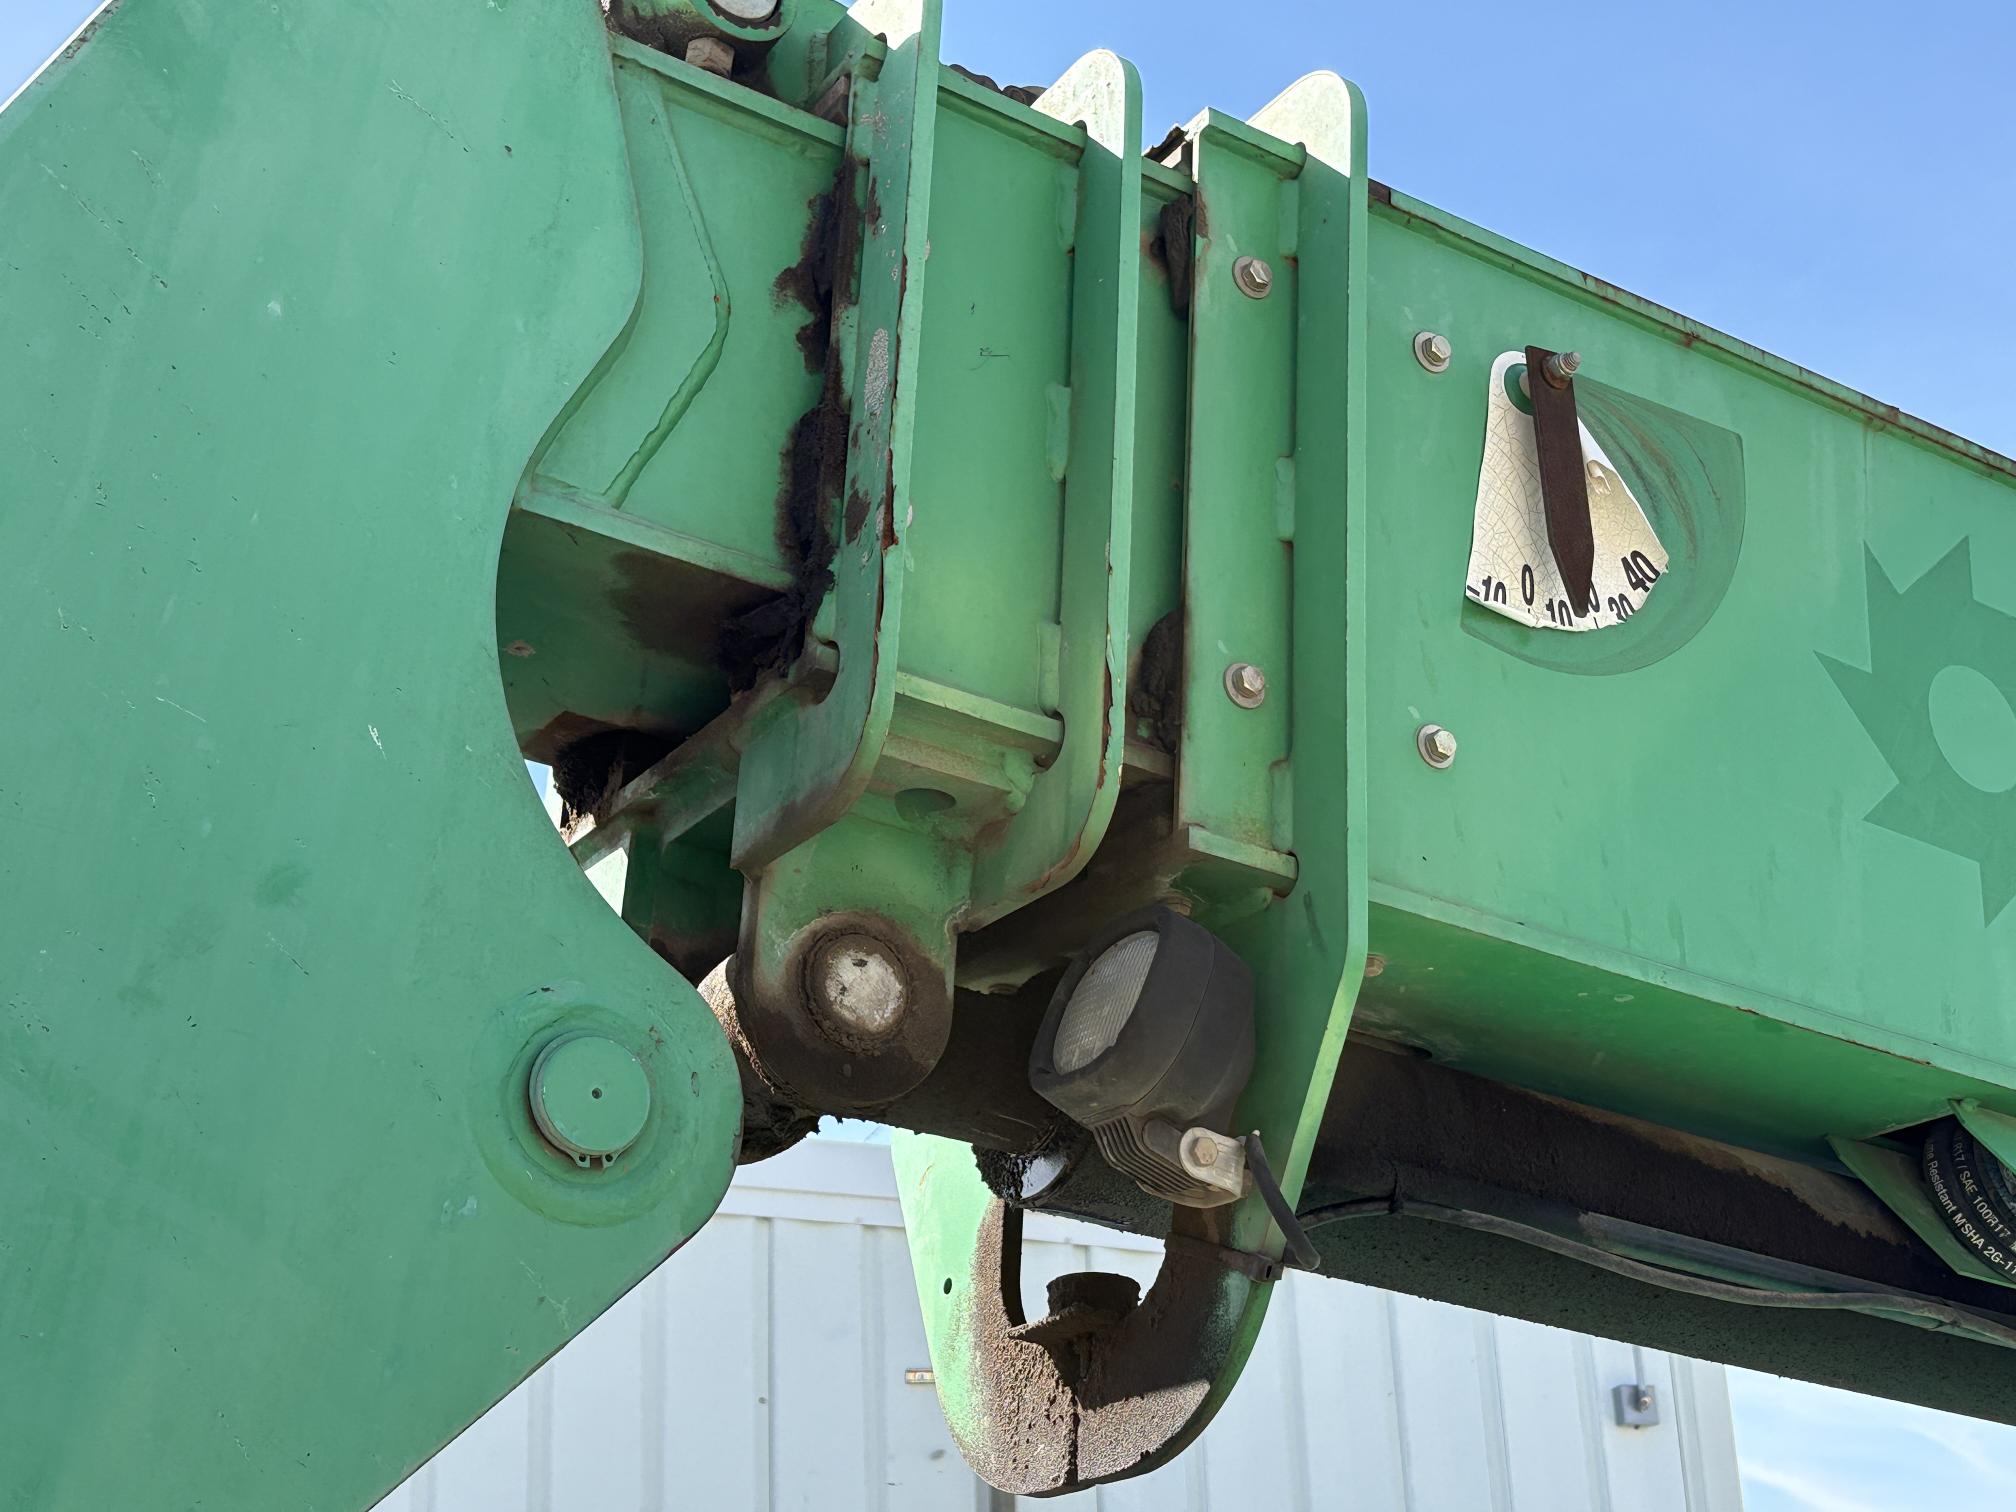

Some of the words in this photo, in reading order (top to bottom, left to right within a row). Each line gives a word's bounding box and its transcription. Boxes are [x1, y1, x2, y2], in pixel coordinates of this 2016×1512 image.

[1521, 564, 1535, 606] 0
[1620, 550, 1661, 593] 40
[1927, 1160, 1957, 1214] Resistant
[1952, 1213, 1985, 1249] MSHA
[1959, 1170, 1978, 1196] SAE
[1972, 1195, 2011, 1238] 100R17
